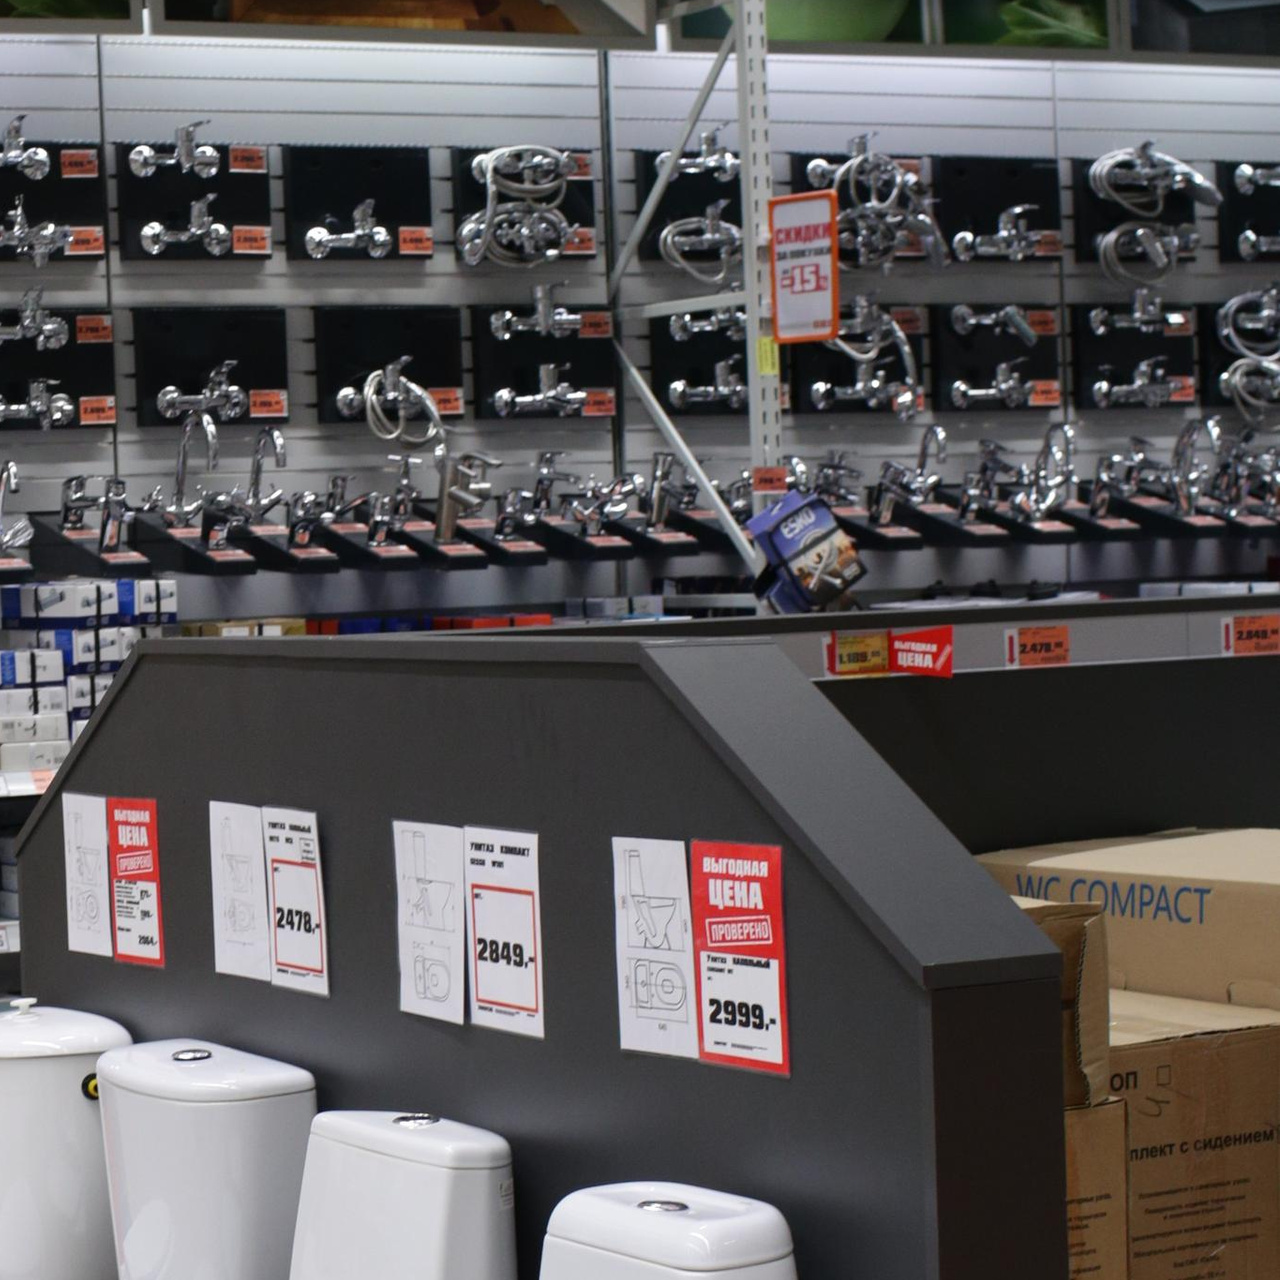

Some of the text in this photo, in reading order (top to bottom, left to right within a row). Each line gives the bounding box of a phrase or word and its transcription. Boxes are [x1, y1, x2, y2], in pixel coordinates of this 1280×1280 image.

[118, 825, 149, 847] ЦЕНА
[703, 857, 768, 877] ВЫГОДНАЯ
[708, 879, 764, 910] ЦЕНА
[1070, 878, 1212, 925] COMPACT
[711, 922, 769, 941] ПРОВЕРЕНО
[1180, 1142, 1188, 1154] с
[1194, 1127, 1274, 1152] сидением
